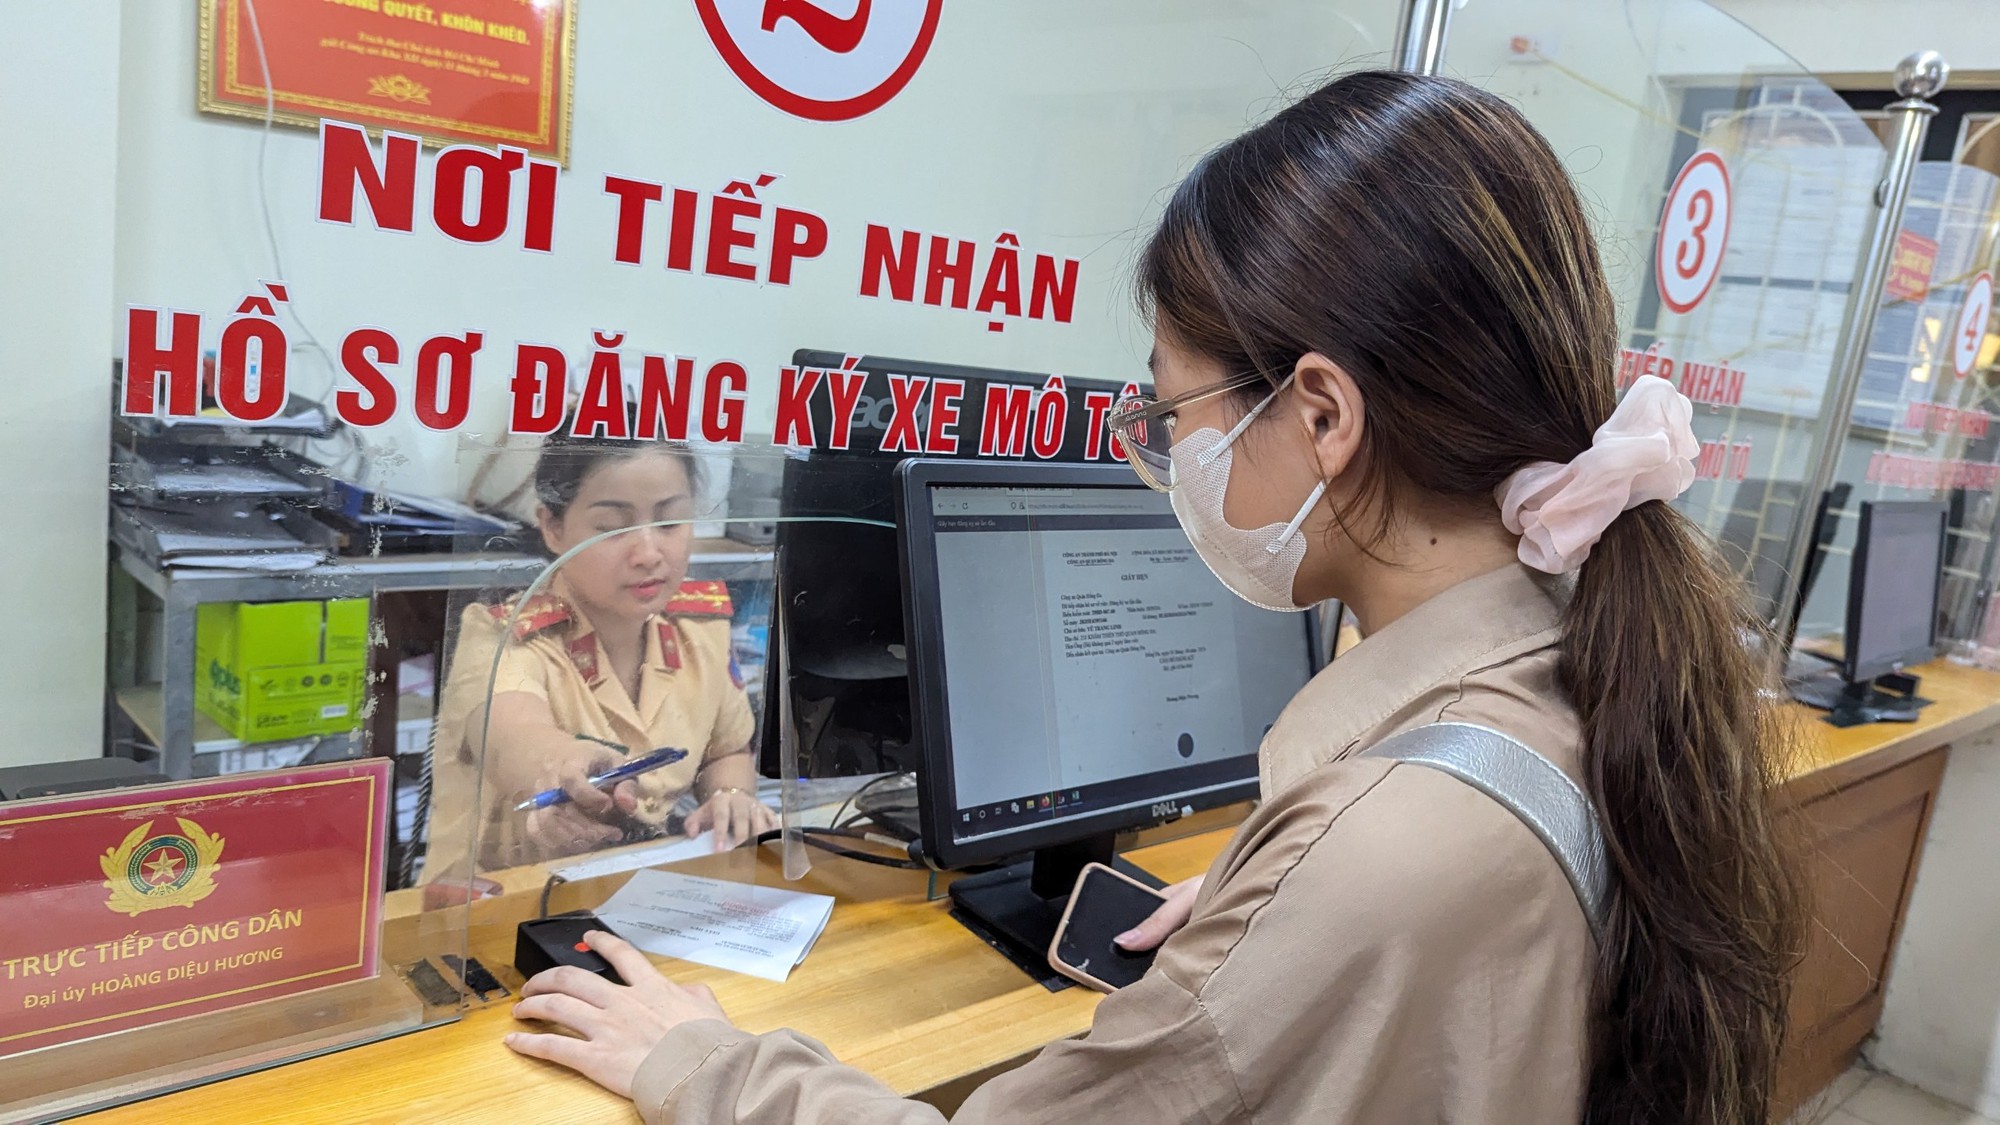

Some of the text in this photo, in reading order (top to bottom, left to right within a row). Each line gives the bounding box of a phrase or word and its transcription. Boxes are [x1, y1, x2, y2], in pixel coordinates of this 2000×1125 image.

[318, 120, 1080, 333] NƠI TIẾP NHẬN
[1676, 189, 1713, 281] 3
[1965, 302, 1983, 352] 4
[124, 282, 289, 422] HỒ
[334, 329, 486, 430] SƠ
[509, 330, 748, 444] ĐĂNG
[772, 356, 867, 449] KÝ
[881, 375, 966, 454] XE
[979, 376, 1067, 458] MÔ
[1679, 358, 1747, 415] NHẬN
[850, 395, 936, 432] acr
[1152, 800, 1177, 818] DELL
[2, 908, 303, 981] TRỰC TIẾP CÔNG DÂN
[23, 947, 283, 1010] Đại úy HOÀNG DIỆU HƯƠNG
